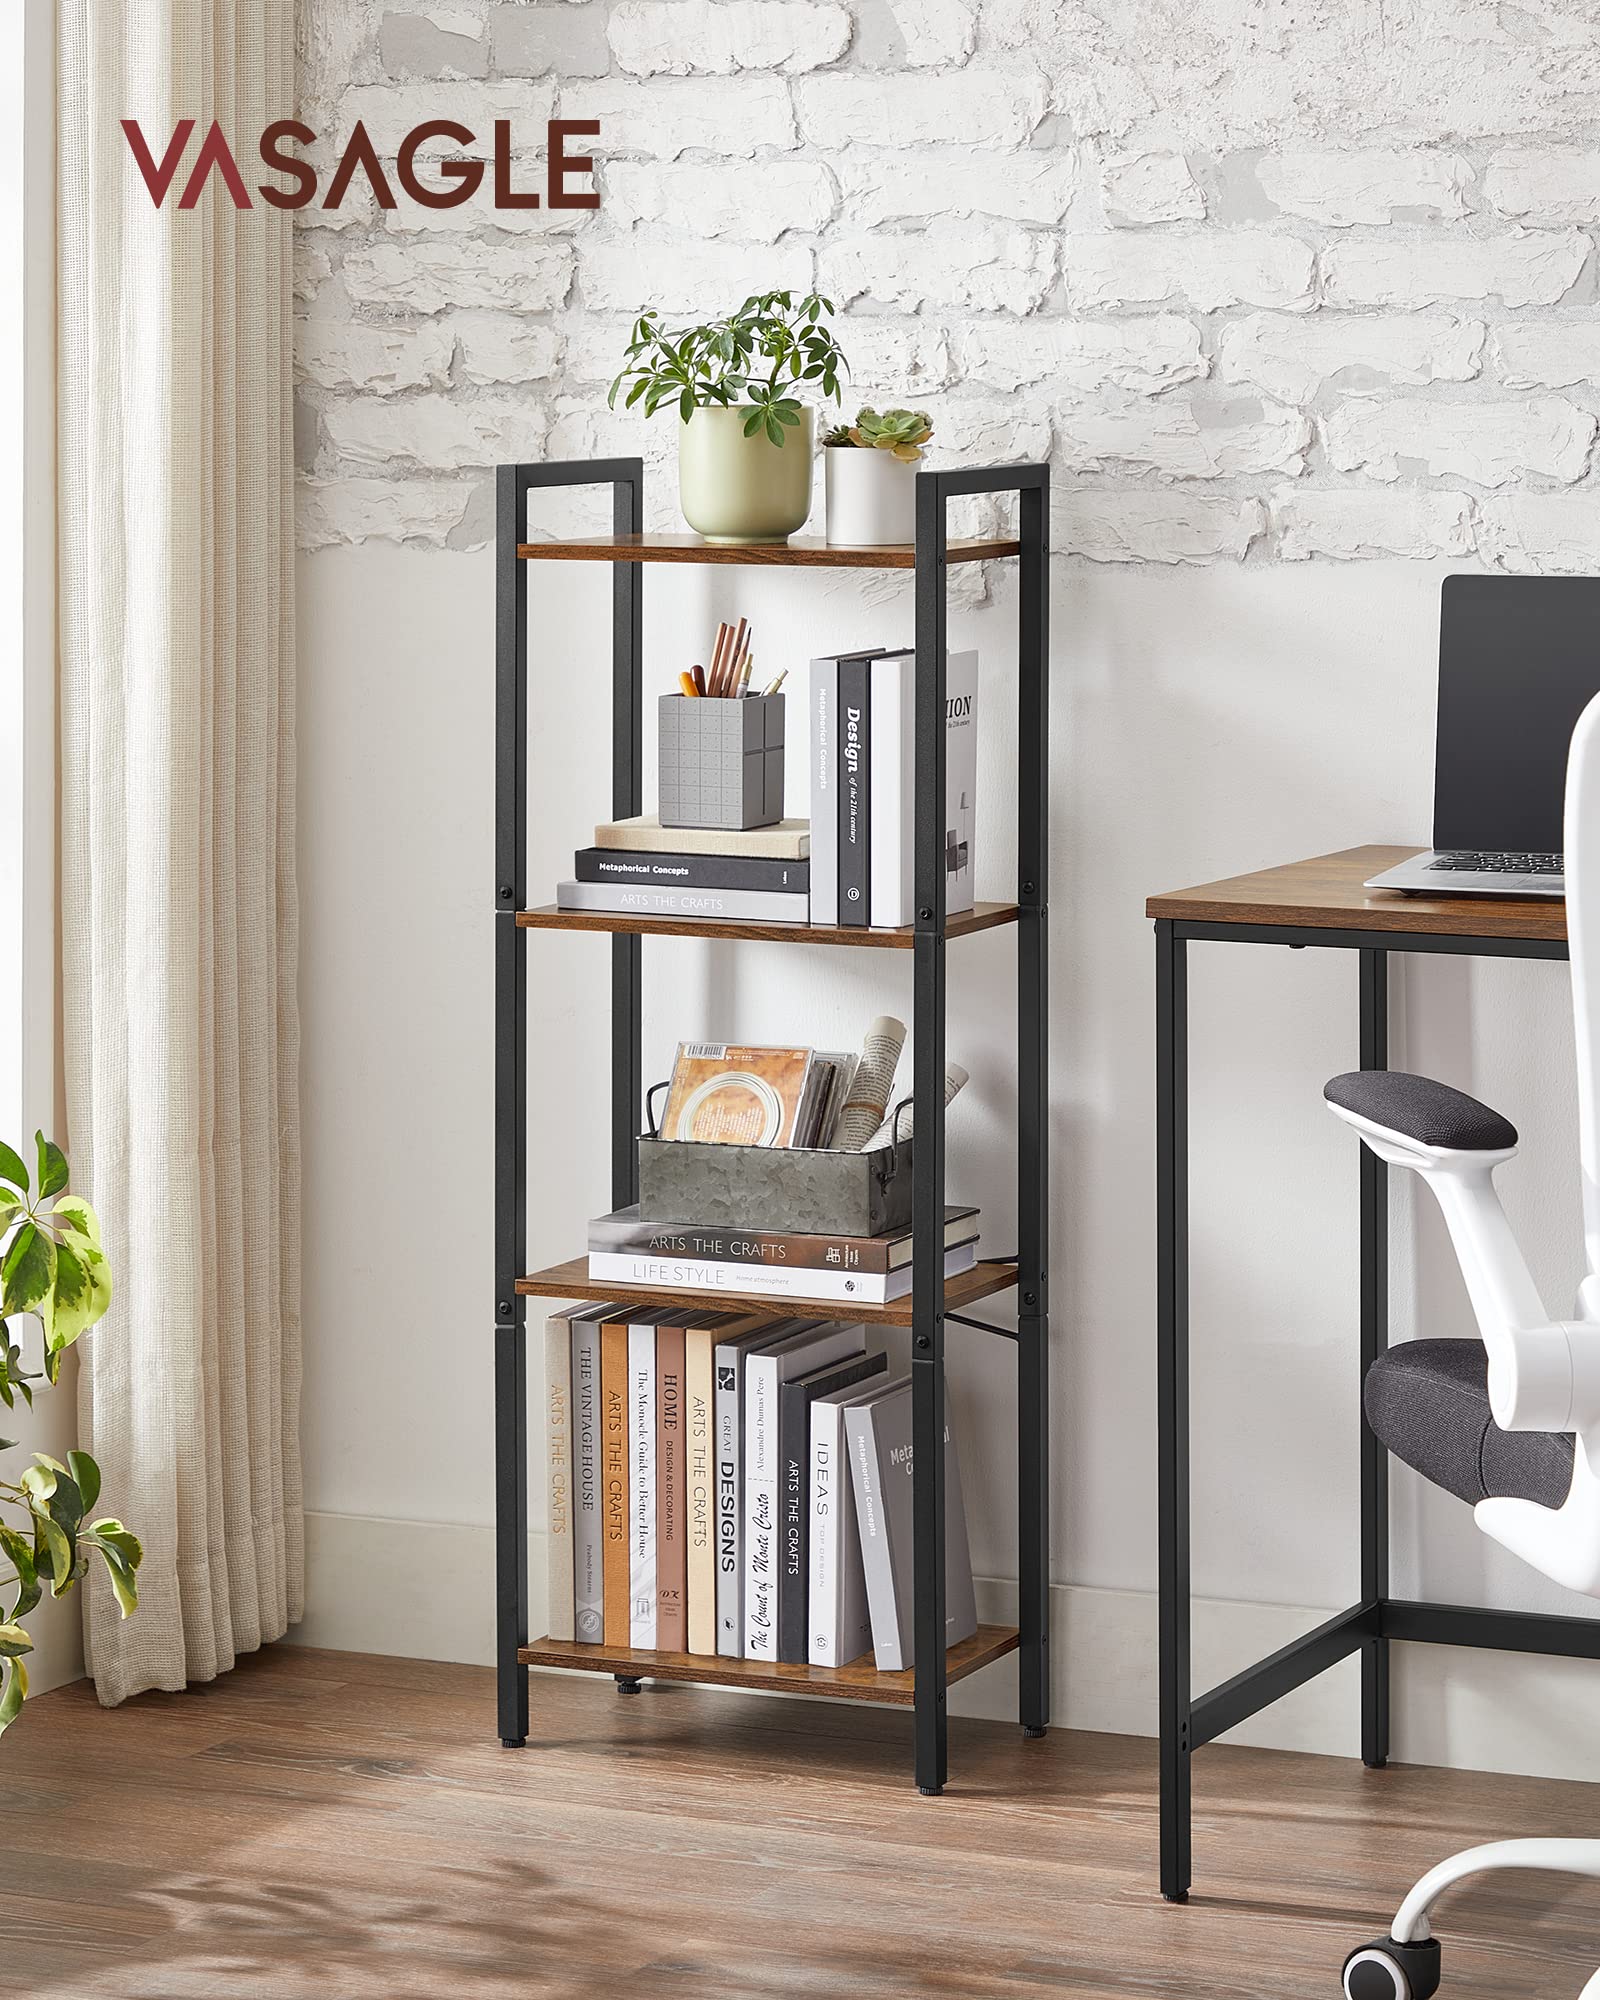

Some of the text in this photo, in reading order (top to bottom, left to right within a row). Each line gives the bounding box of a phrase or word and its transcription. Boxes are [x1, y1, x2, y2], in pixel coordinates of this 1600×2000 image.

[819, 688, 828, 789] Metaphorical Concepts
[844, 706, 862, 773] Design
[848, 777, 858, 787] of
[850, 787, 858, 800] the
[599, 862, 690, 877] Metaphorical Concepts
[620, 893, 724, 910] ARTS THE CRAFTS
[633, 1263, 726, 1285] LIFE STYLE
[650, 1235, 787, 1260] ARTS THE CRAFTS
[580, 1347, 592, 1379] THE
[663, 1374, 678, 1431] HOME
[756, 1398, 764, 1427] Dumas
[551, 1384, 566, 1535] ARTS THE CRAFTS
[608, 1390, 622, 1541] ARTS THE CRAFTS
[638, 1369, 649, 1559] The Monocle Guide to Better House
[665, 1440, 674, 1474] DESIGN
[693, 1396, 707, 1547] ARTS THE CRAFTS
[756, 1428, 764, 1472] Alexandre
[816, 1442, 829, 1516] IDEAS
[665, 1483, 674, 1541] DECORATING
[720, 1415, 735, 1573] GREAT DESIGNS
[857, 1435, 877, 1537] Metaphorical Concepts
[787, 1459, 799, 1575] ARTS THE CRAFTS
[750, 1492, 774, 1651] The Count of Monte Cristo
